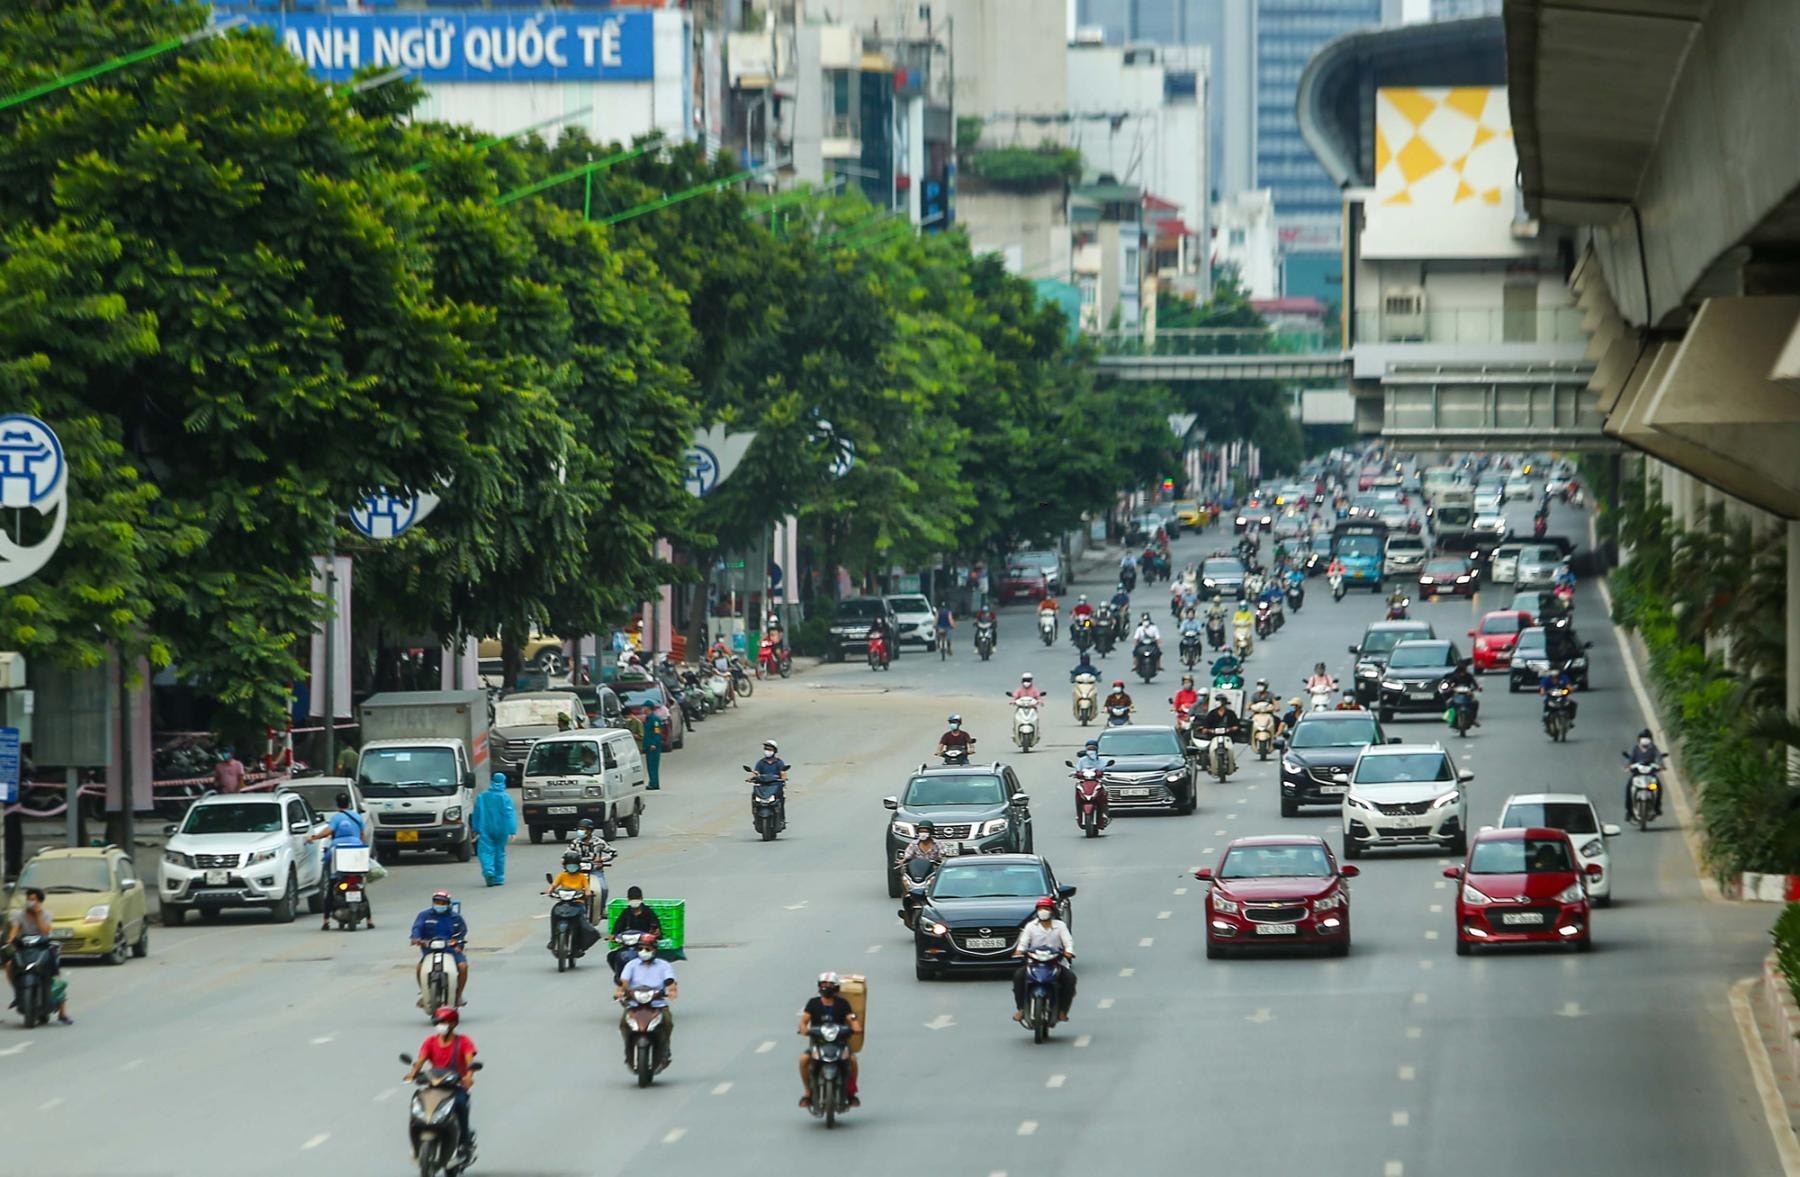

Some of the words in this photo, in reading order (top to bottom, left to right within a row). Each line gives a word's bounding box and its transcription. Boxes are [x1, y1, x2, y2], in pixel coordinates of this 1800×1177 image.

[284, 26, 361, 70] ANH
[373, 17, 456, 70] NGỮ
[464, 12, 568, 72] QUỐC
[577, 12, 625, 68] TẾ
[546, 779, 578, 787] SUZUKI
